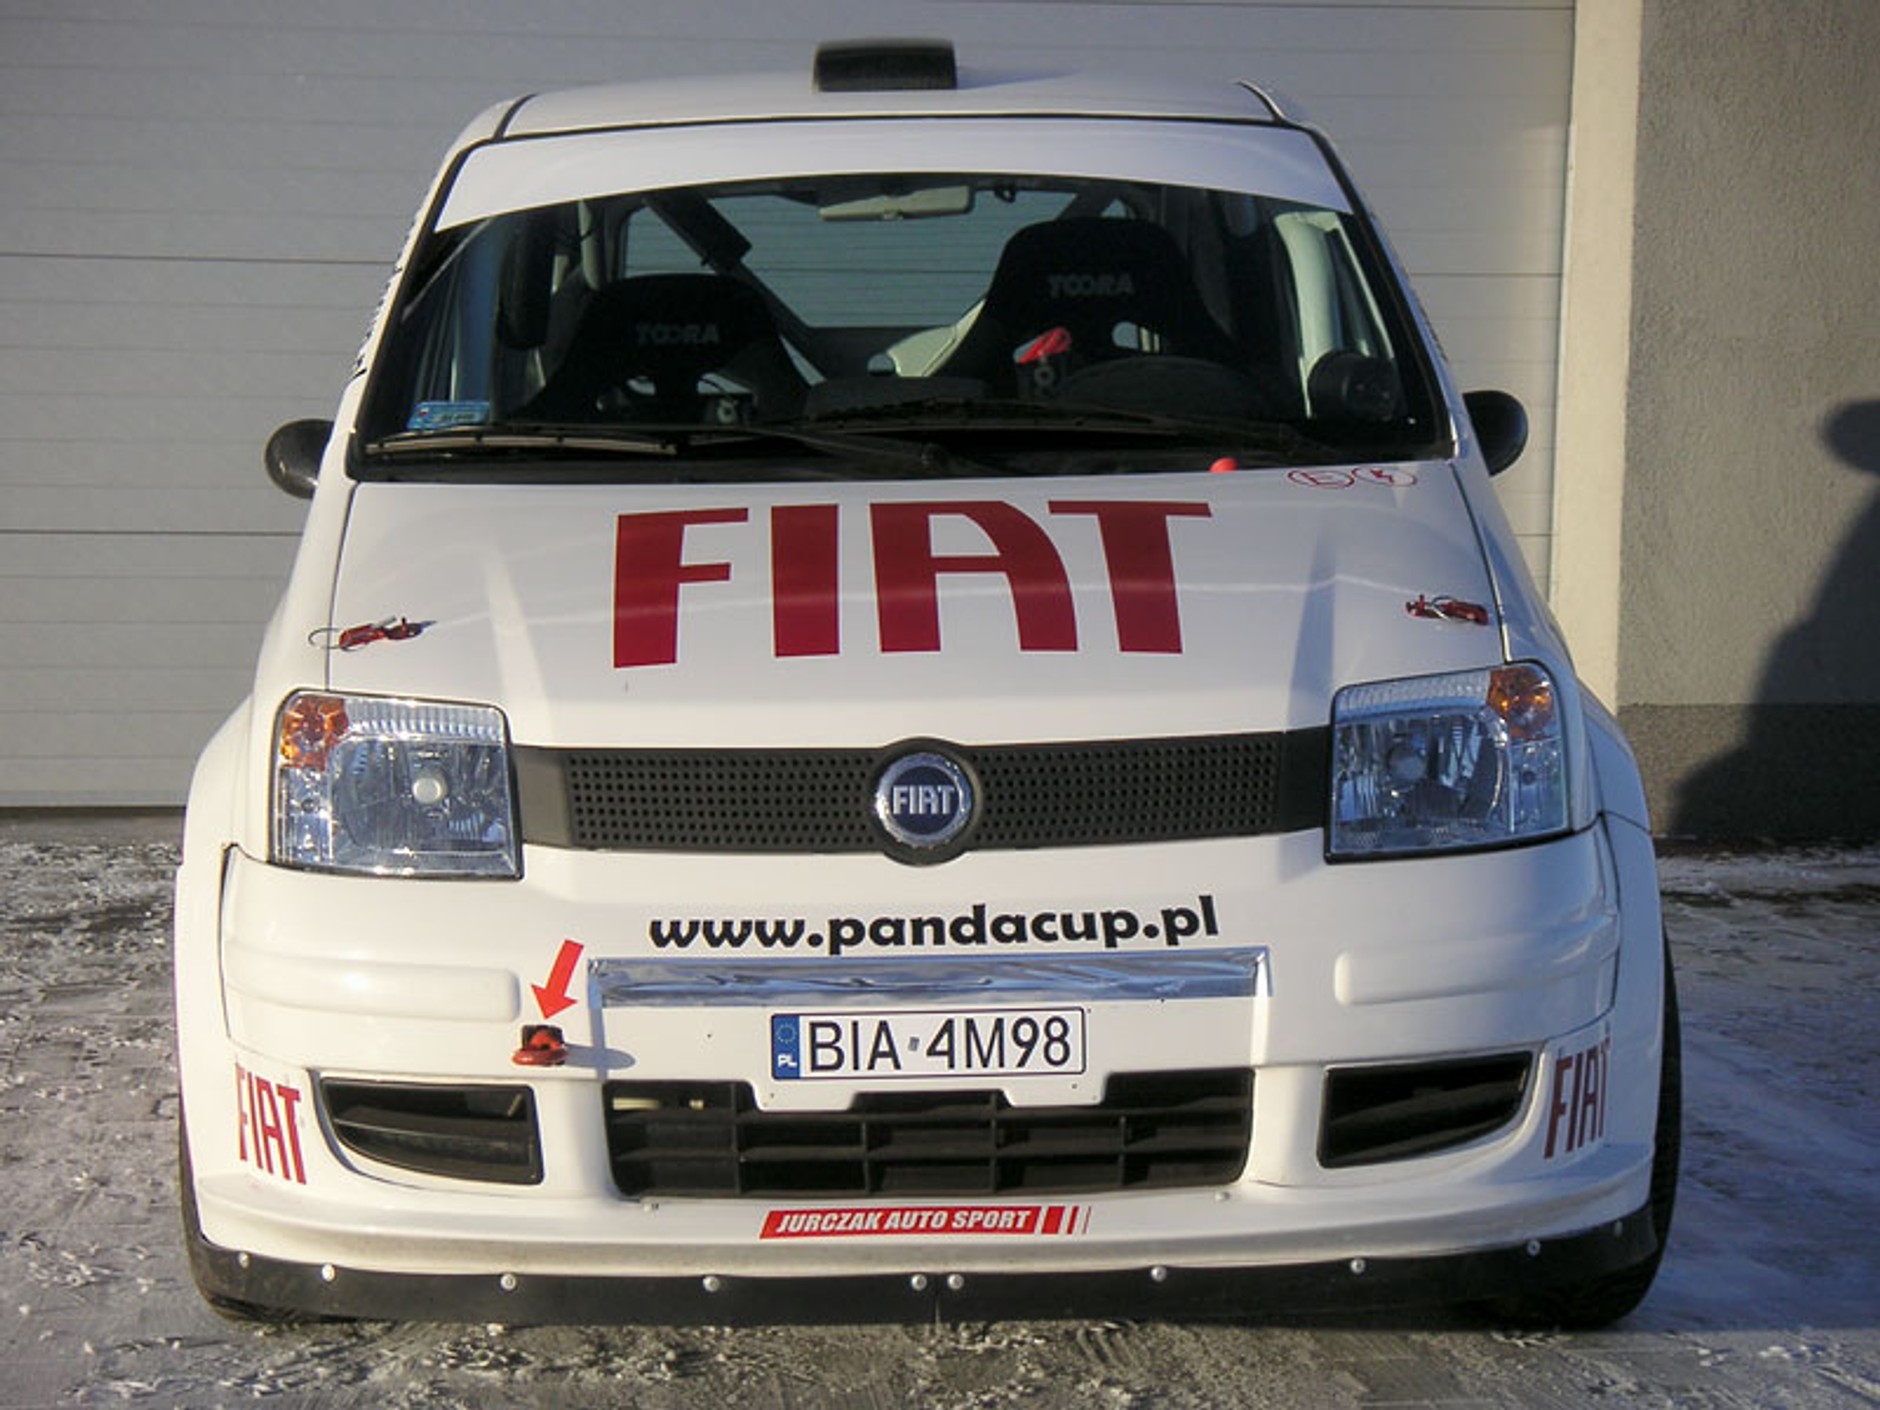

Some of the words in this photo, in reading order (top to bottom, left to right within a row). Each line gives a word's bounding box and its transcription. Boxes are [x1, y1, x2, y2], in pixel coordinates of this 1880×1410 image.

[1048, 273, 1135, 299] TOORA
[613, 500, 1212, 669] FIAT
[892, 785, 955, 815] FIAT
[649, 894, 1219, 956] www.pandacup.pl
[777, 1053, 797, 1068] PL
[808, 1020, 901, 1072] BIA
[925, 1016, 1071, 1069] 4M98
[234, 1060, 307, 1185] FIAT
[1543, 1036, 1611, 1160] FIAT
[775, 1211, 882, 1233] JURCZAK
[882, 1209, 948, 1231] AUTO
[950, 1208, 1032, 1230] SPORT
